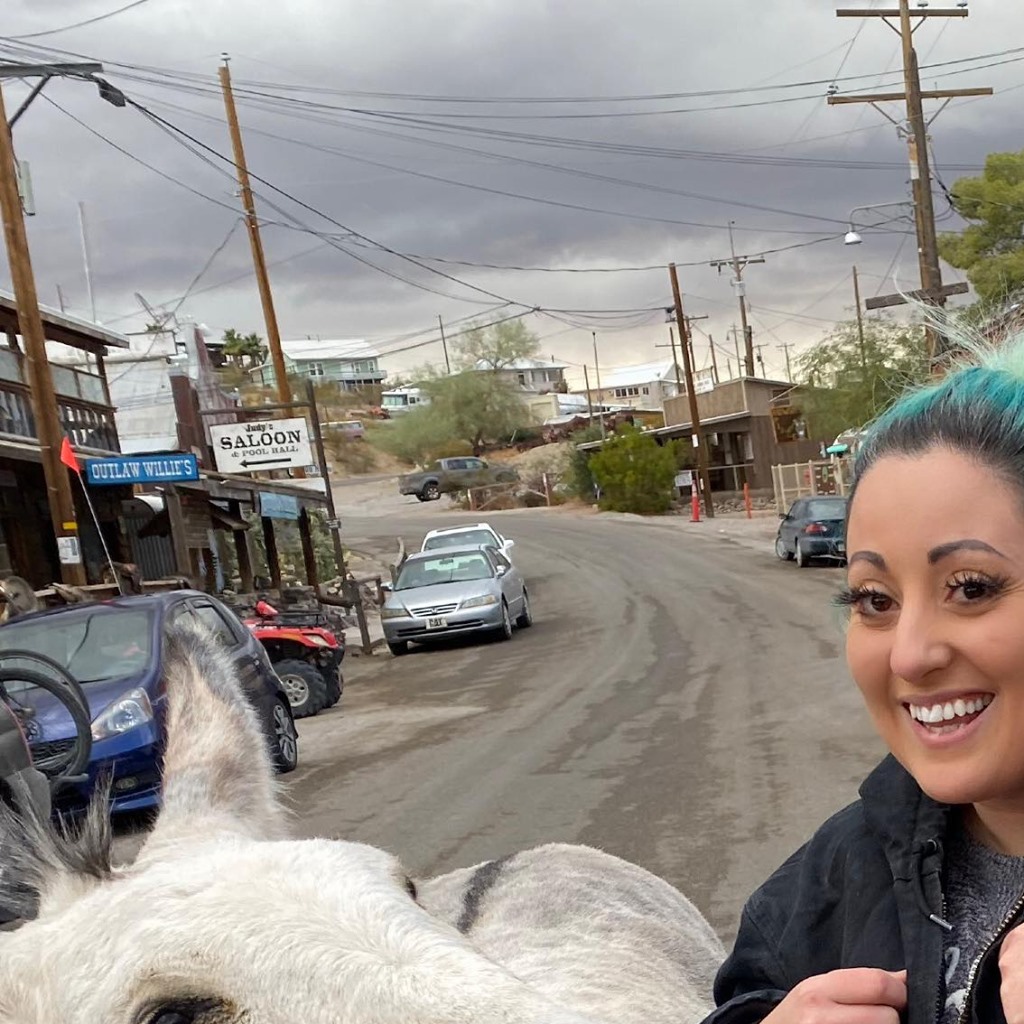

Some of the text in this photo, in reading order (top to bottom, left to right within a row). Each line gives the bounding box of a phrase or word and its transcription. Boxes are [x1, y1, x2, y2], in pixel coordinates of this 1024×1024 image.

[245, 423, 273, 433] Judy's
[220, 430, 301, 450] SALOON
[242, 448, 269, 457] POOL
[271, 446, 299, 454] HALL
[91, 459, 192, 479] OUTLAW WILLIE'S
